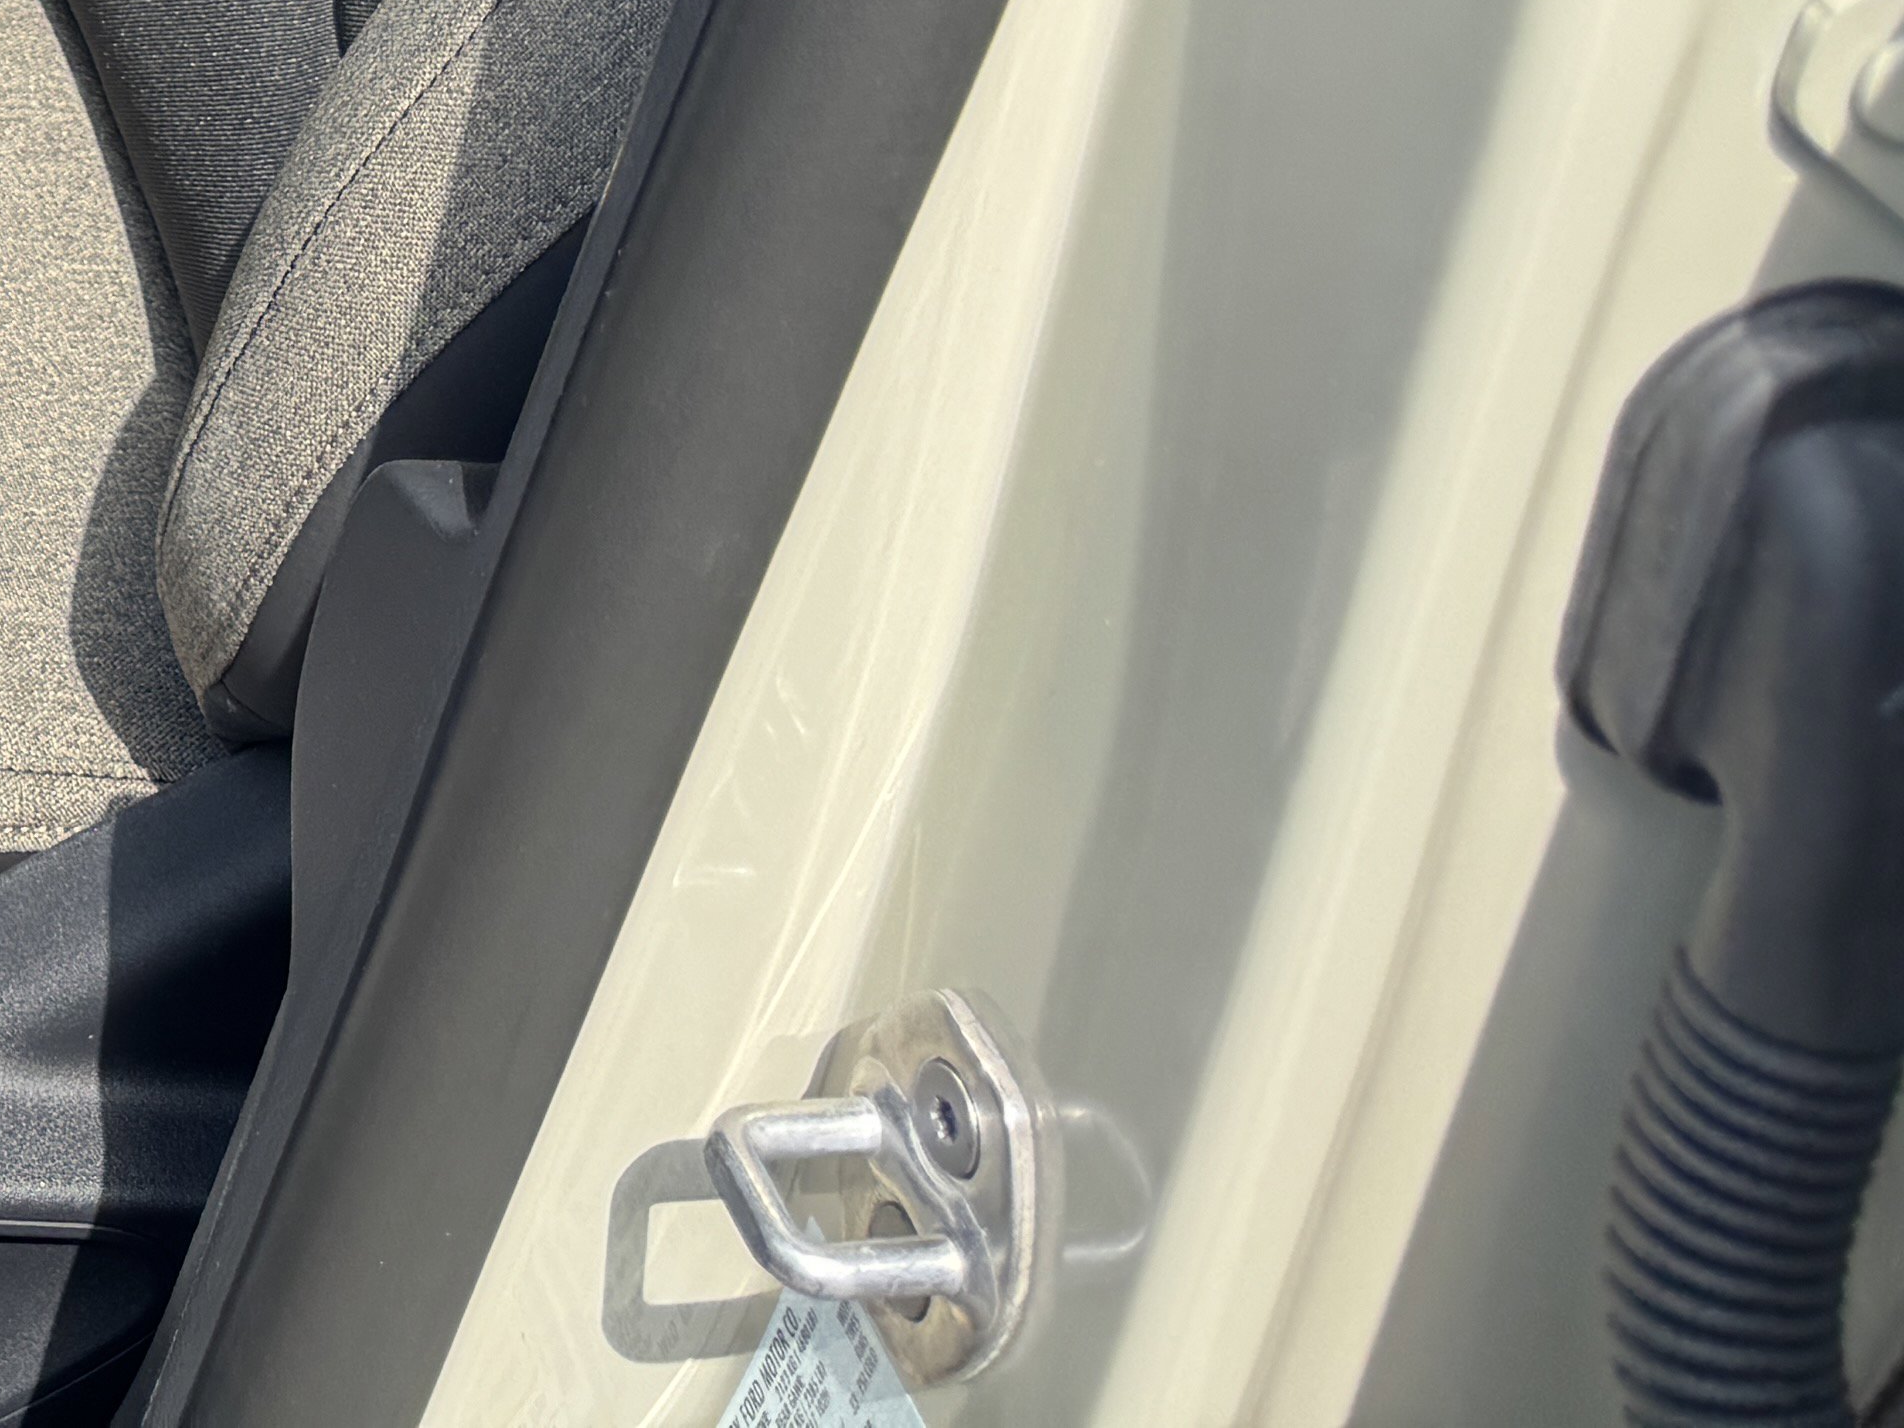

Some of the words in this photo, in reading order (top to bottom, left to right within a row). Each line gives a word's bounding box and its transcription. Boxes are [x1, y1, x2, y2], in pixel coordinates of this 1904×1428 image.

[739, 1379, 766, 1427] FORD
[759, 1328, 791, 1390] MOTOR
[782, 1306, 802, 1338] CO.
